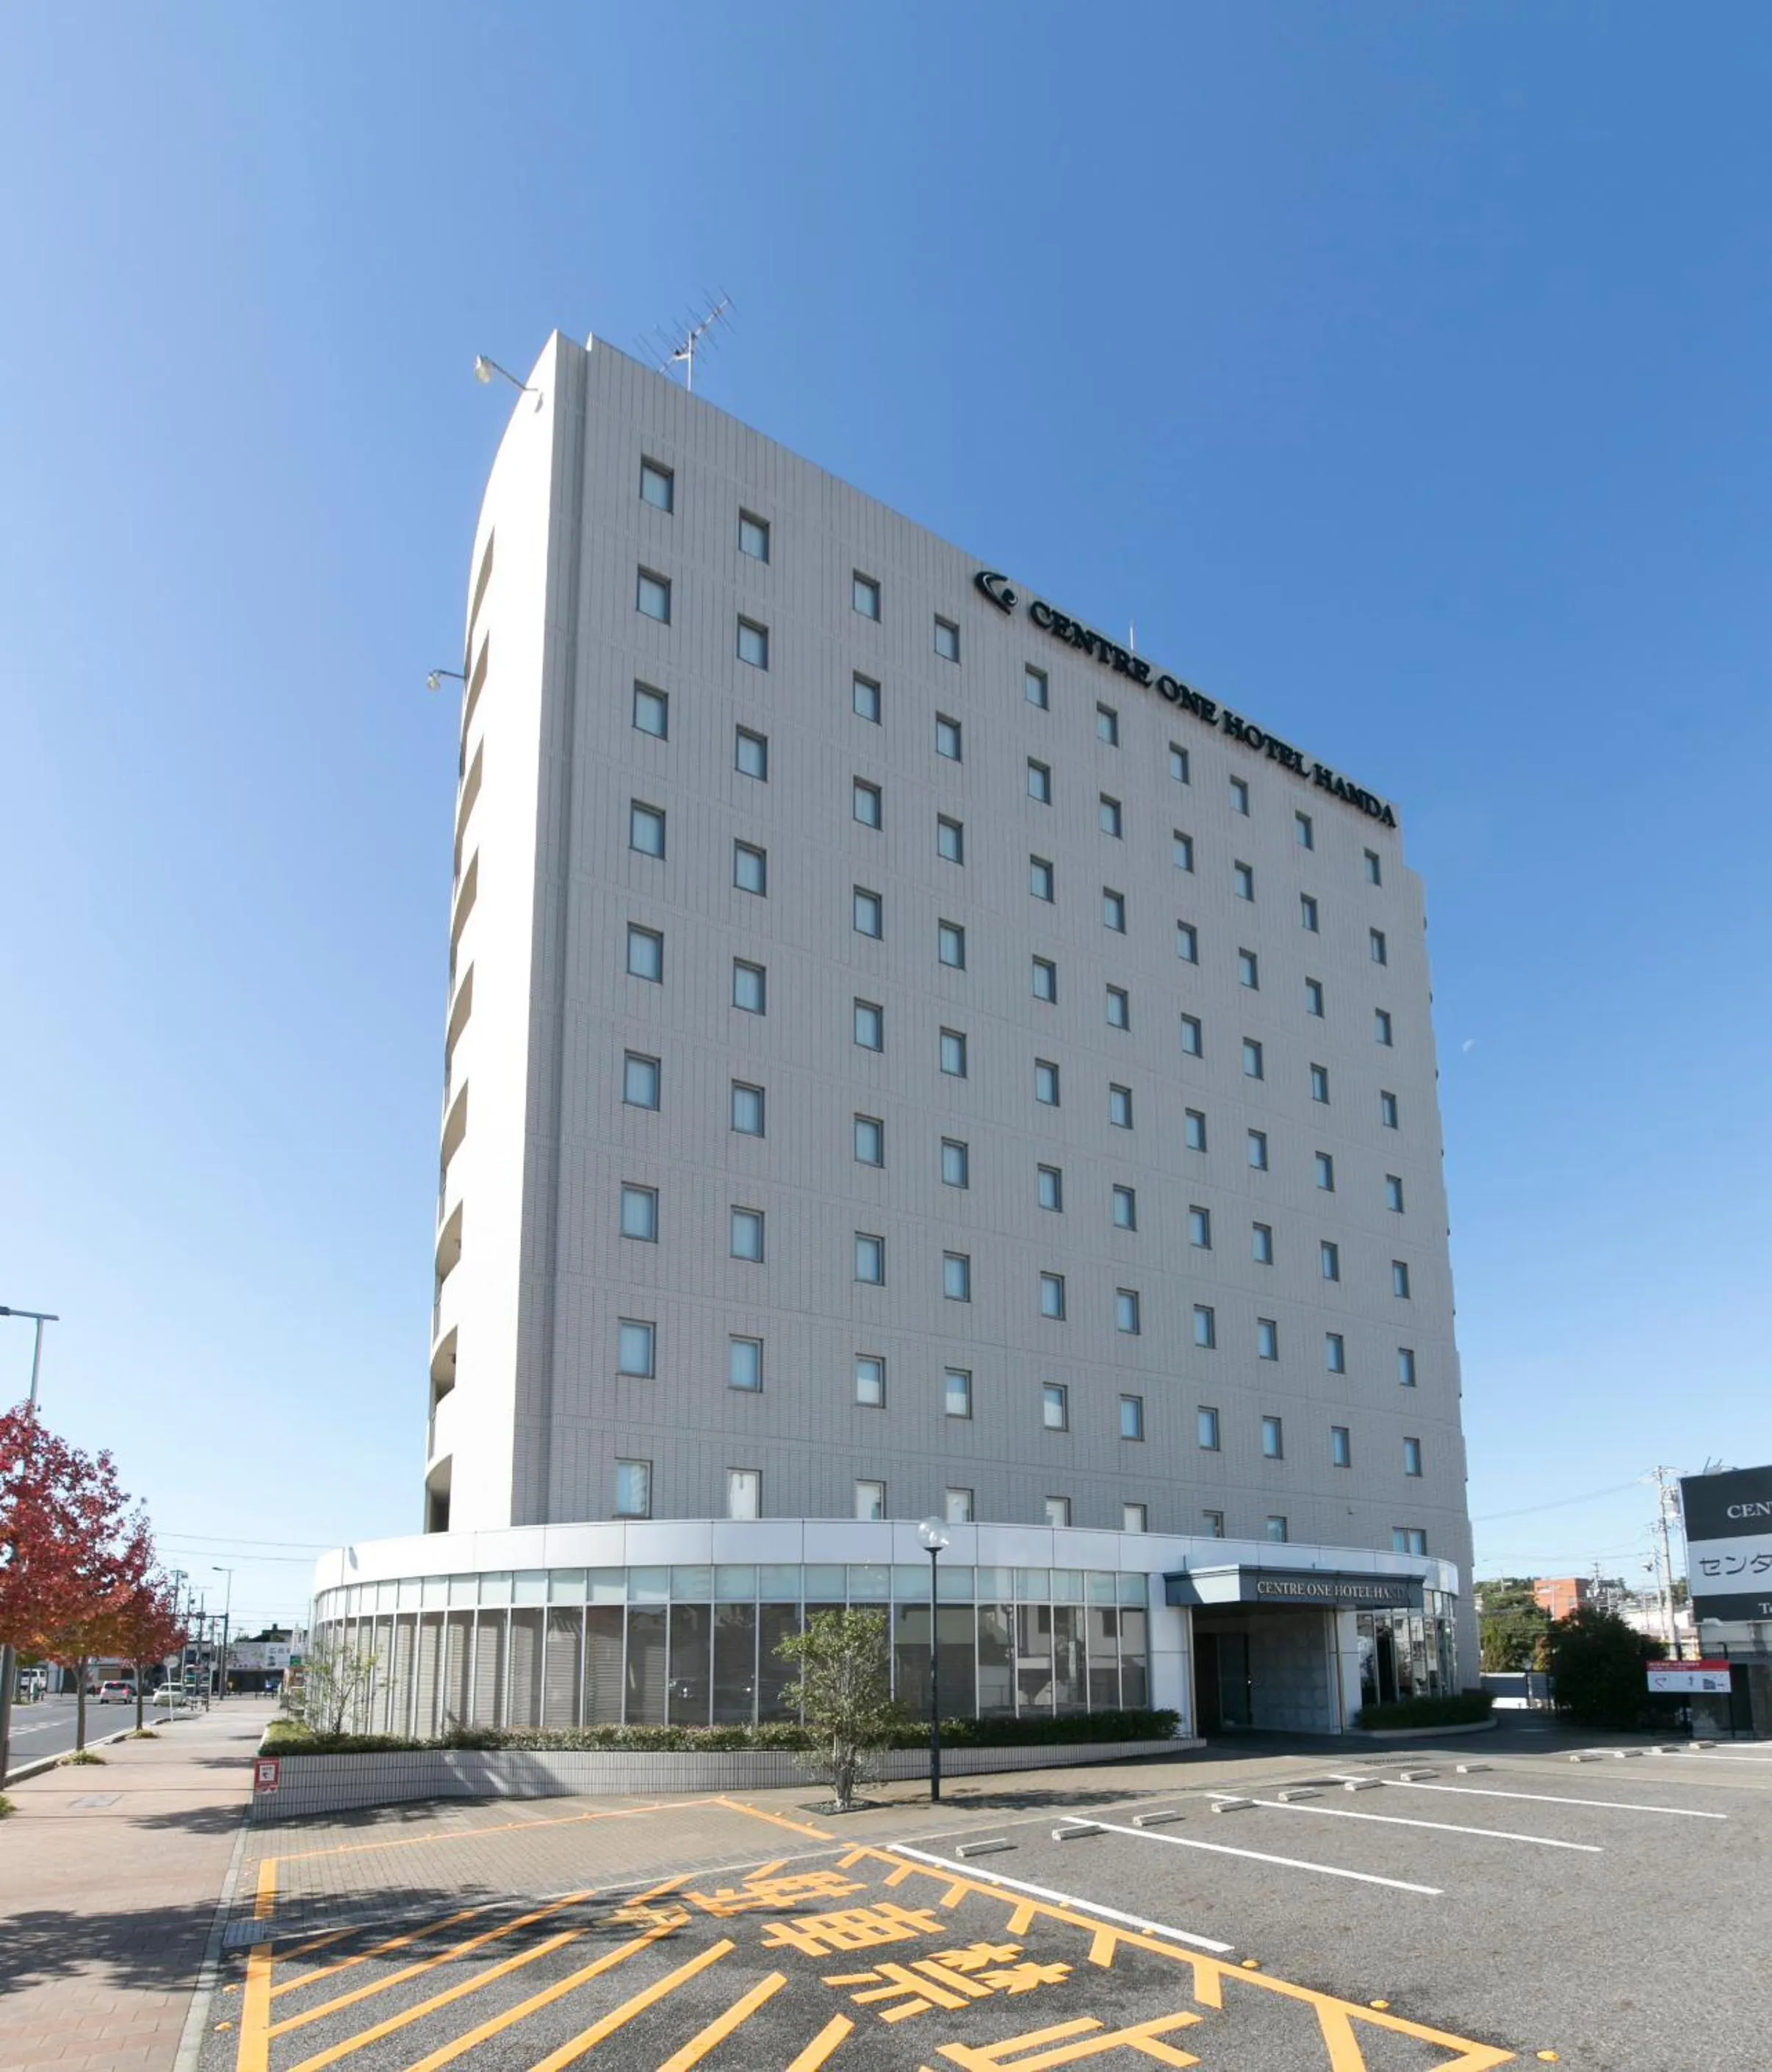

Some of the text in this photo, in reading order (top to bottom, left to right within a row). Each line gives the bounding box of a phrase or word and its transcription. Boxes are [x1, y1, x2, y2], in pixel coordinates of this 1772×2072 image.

[1030, 600, 1397, 828] CENTRE ONE HOTEL HANDA
[1257, 1580, 1305, 1595] CENTRE
[1307, 1584, 1333, 1597] ONE
[1335, 1585, 1372, 1598] HOTEL
[682, 1871, 1203, 2072] 駐車禁止
